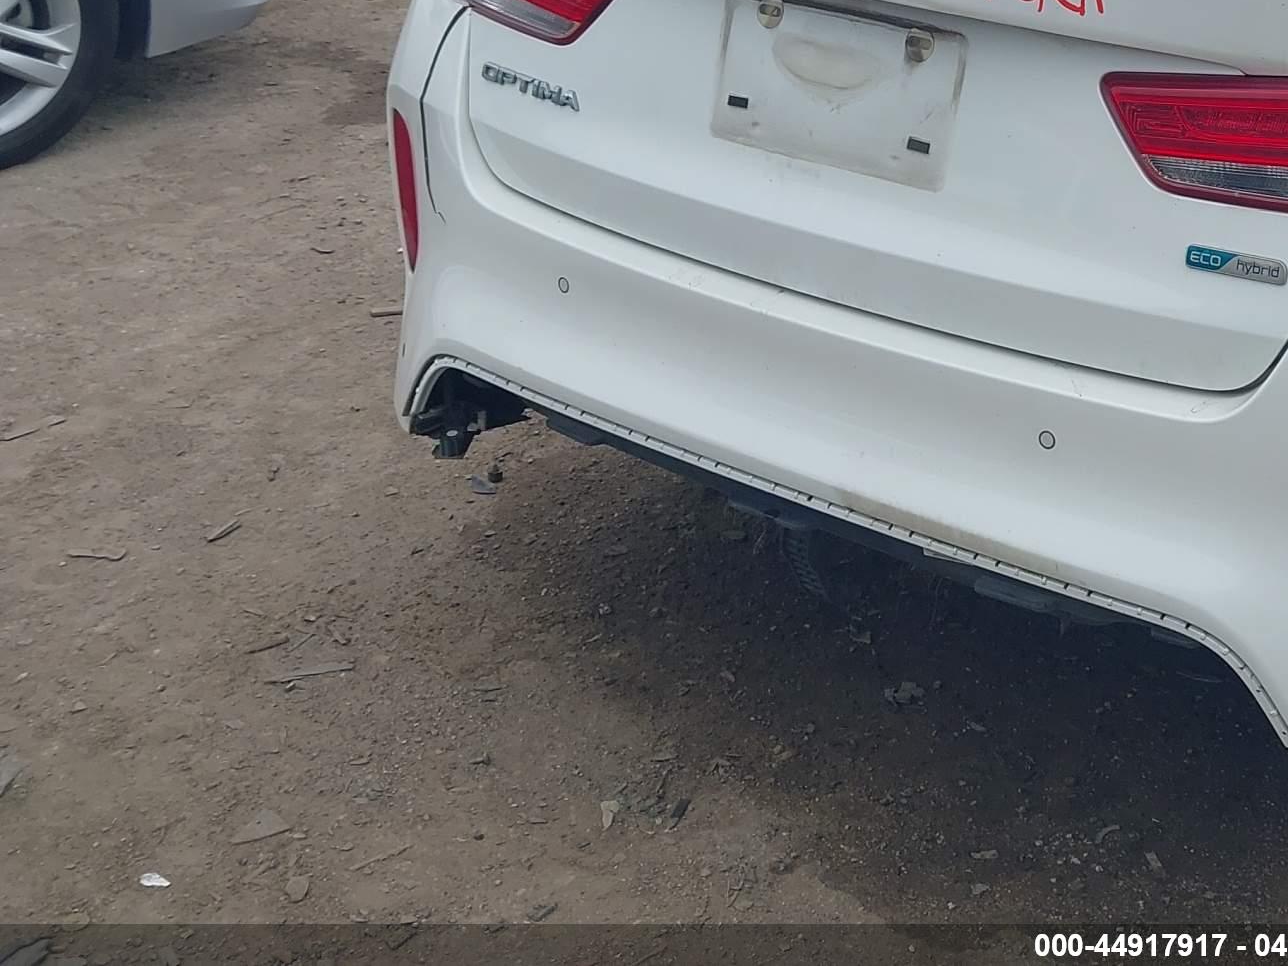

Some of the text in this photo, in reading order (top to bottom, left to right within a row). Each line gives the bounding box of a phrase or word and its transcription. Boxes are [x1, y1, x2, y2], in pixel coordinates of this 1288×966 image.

[481, 61, 580, 112] OPTIMA
[1190, 251, 1280, 278] ECO hybrid
